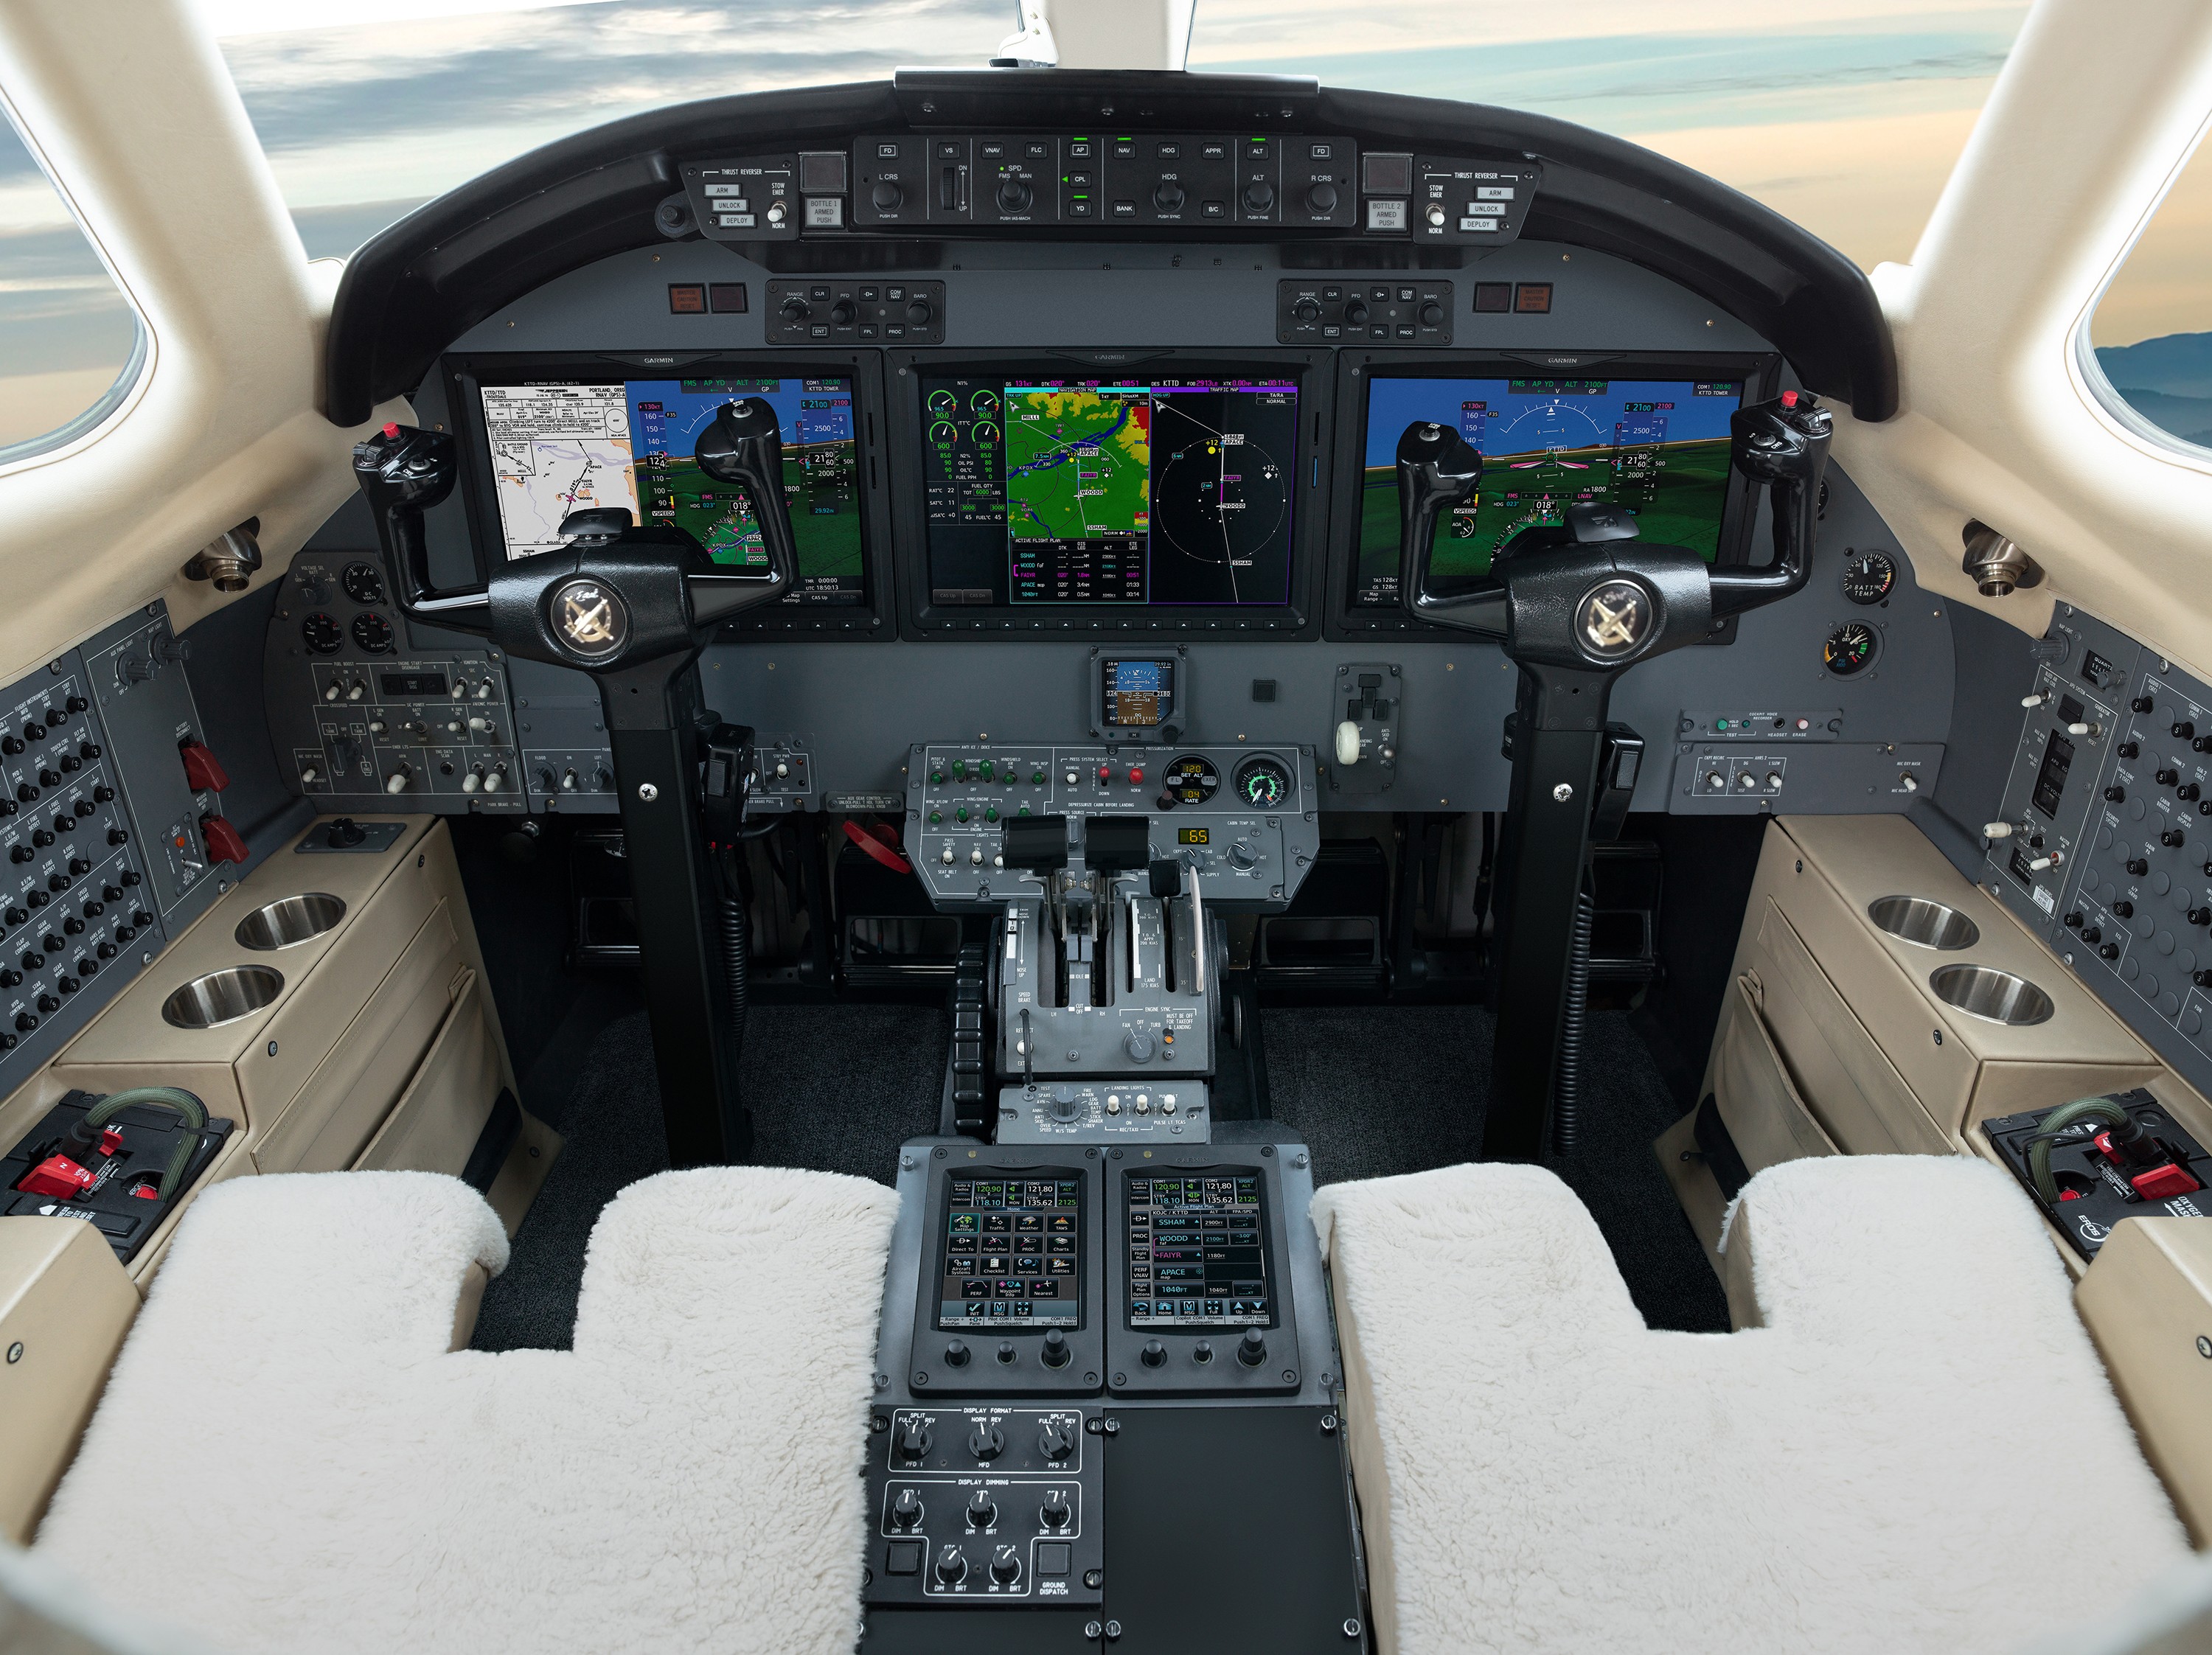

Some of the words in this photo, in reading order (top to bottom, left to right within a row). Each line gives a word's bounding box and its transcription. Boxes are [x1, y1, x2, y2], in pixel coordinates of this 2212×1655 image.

[1190, 830, 1206, 842] 65
[2170, 1200, 2191, 1217] MAS
[2078, 1215, 2101, 1236] EROS
